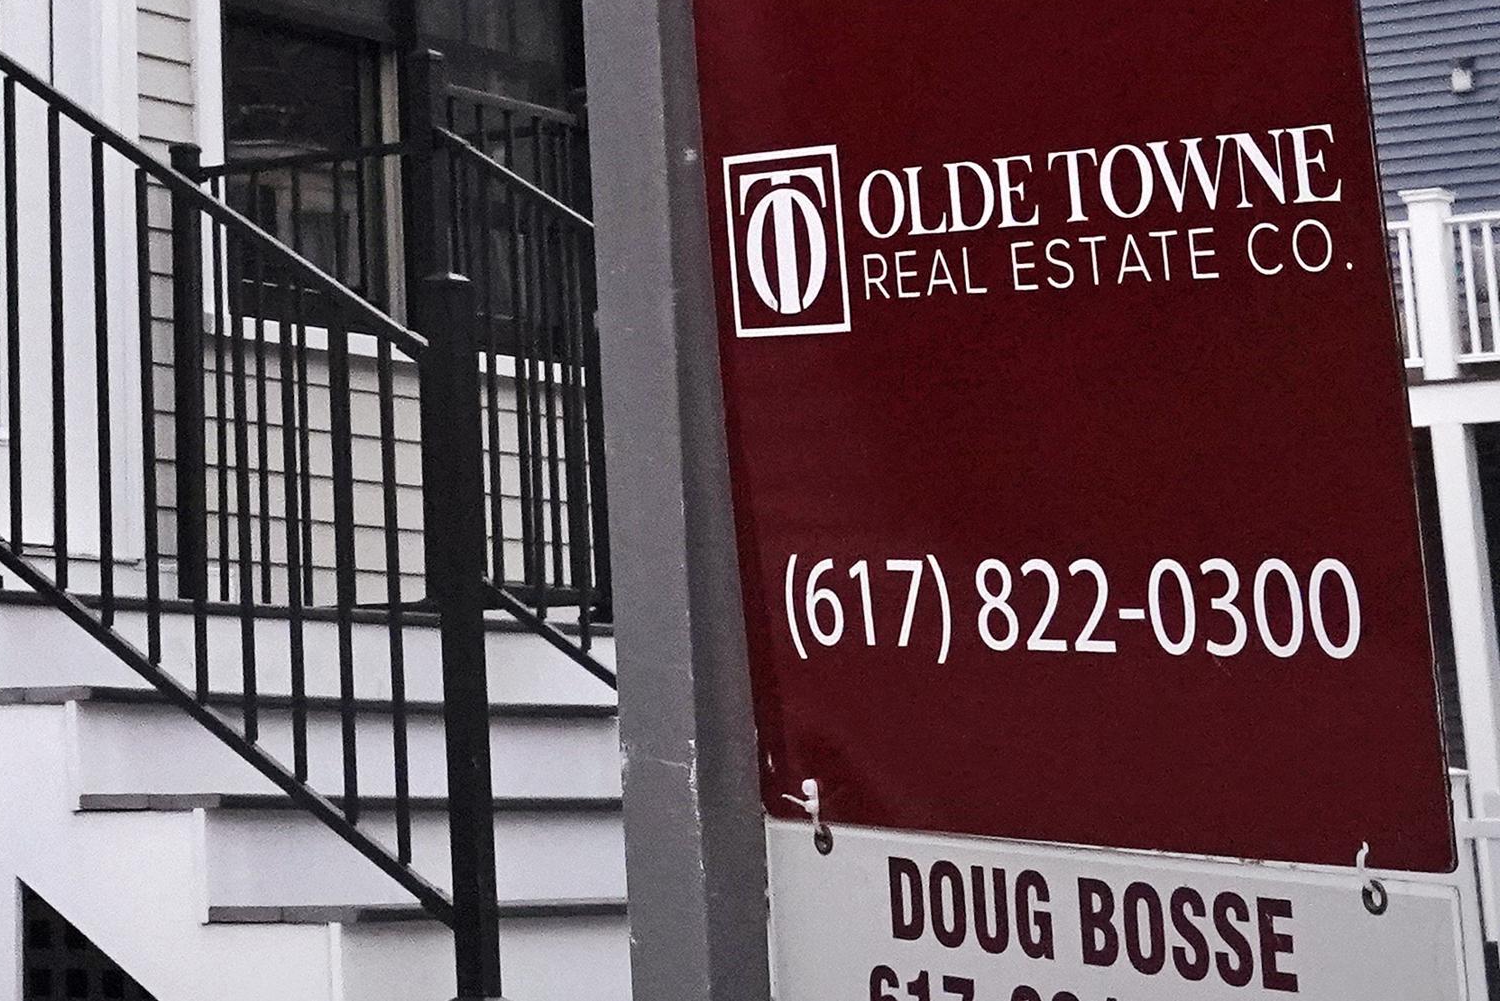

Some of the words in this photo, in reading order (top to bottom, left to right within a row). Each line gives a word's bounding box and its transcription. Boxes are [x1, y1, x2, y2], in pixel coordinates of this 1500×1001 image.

[858, 154, 1040, 239] OLDE
[1047, 123, 1342, 223] TOWNE
[862, 246, 988, 301] REAL
[1010, 227, 1220, 291] ESTATE
[1247, 218, 1353, 276] CO.
[785, 553, 952, 665] (617)
[975, 557, 1361, 660] 822-0300
[887, 855, 1055, 961] DOUG
[1077, 876, 1300, 994] BOSSE
